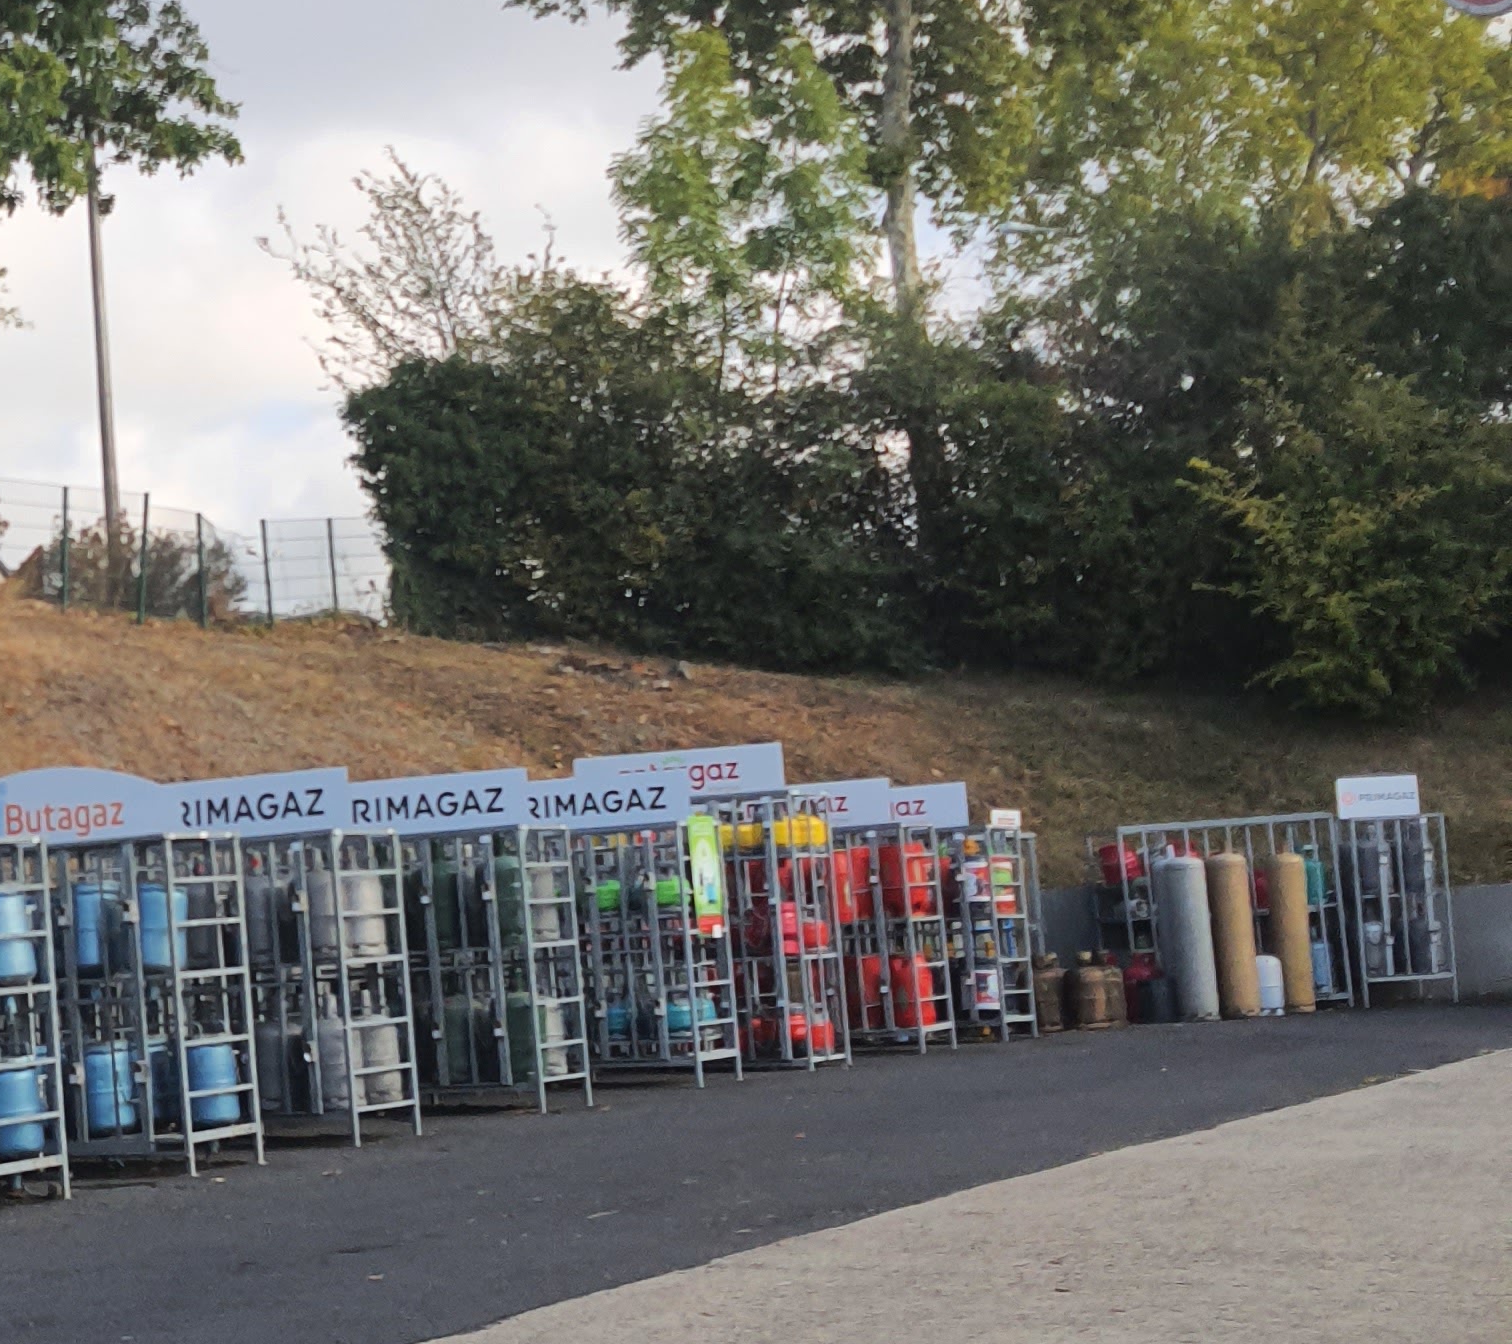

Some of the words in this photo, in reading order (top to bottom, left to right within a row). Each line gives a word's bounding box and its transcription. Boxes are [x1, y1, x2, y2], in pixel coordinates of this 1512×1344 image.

[5, 802, 125, 837] Butagaz
[181, 788, 325, 827] RIMAGAZ
[352, 787, 504, 824] RIMAGAZ
[528, 786, 666, 819] RIMAGAZ
